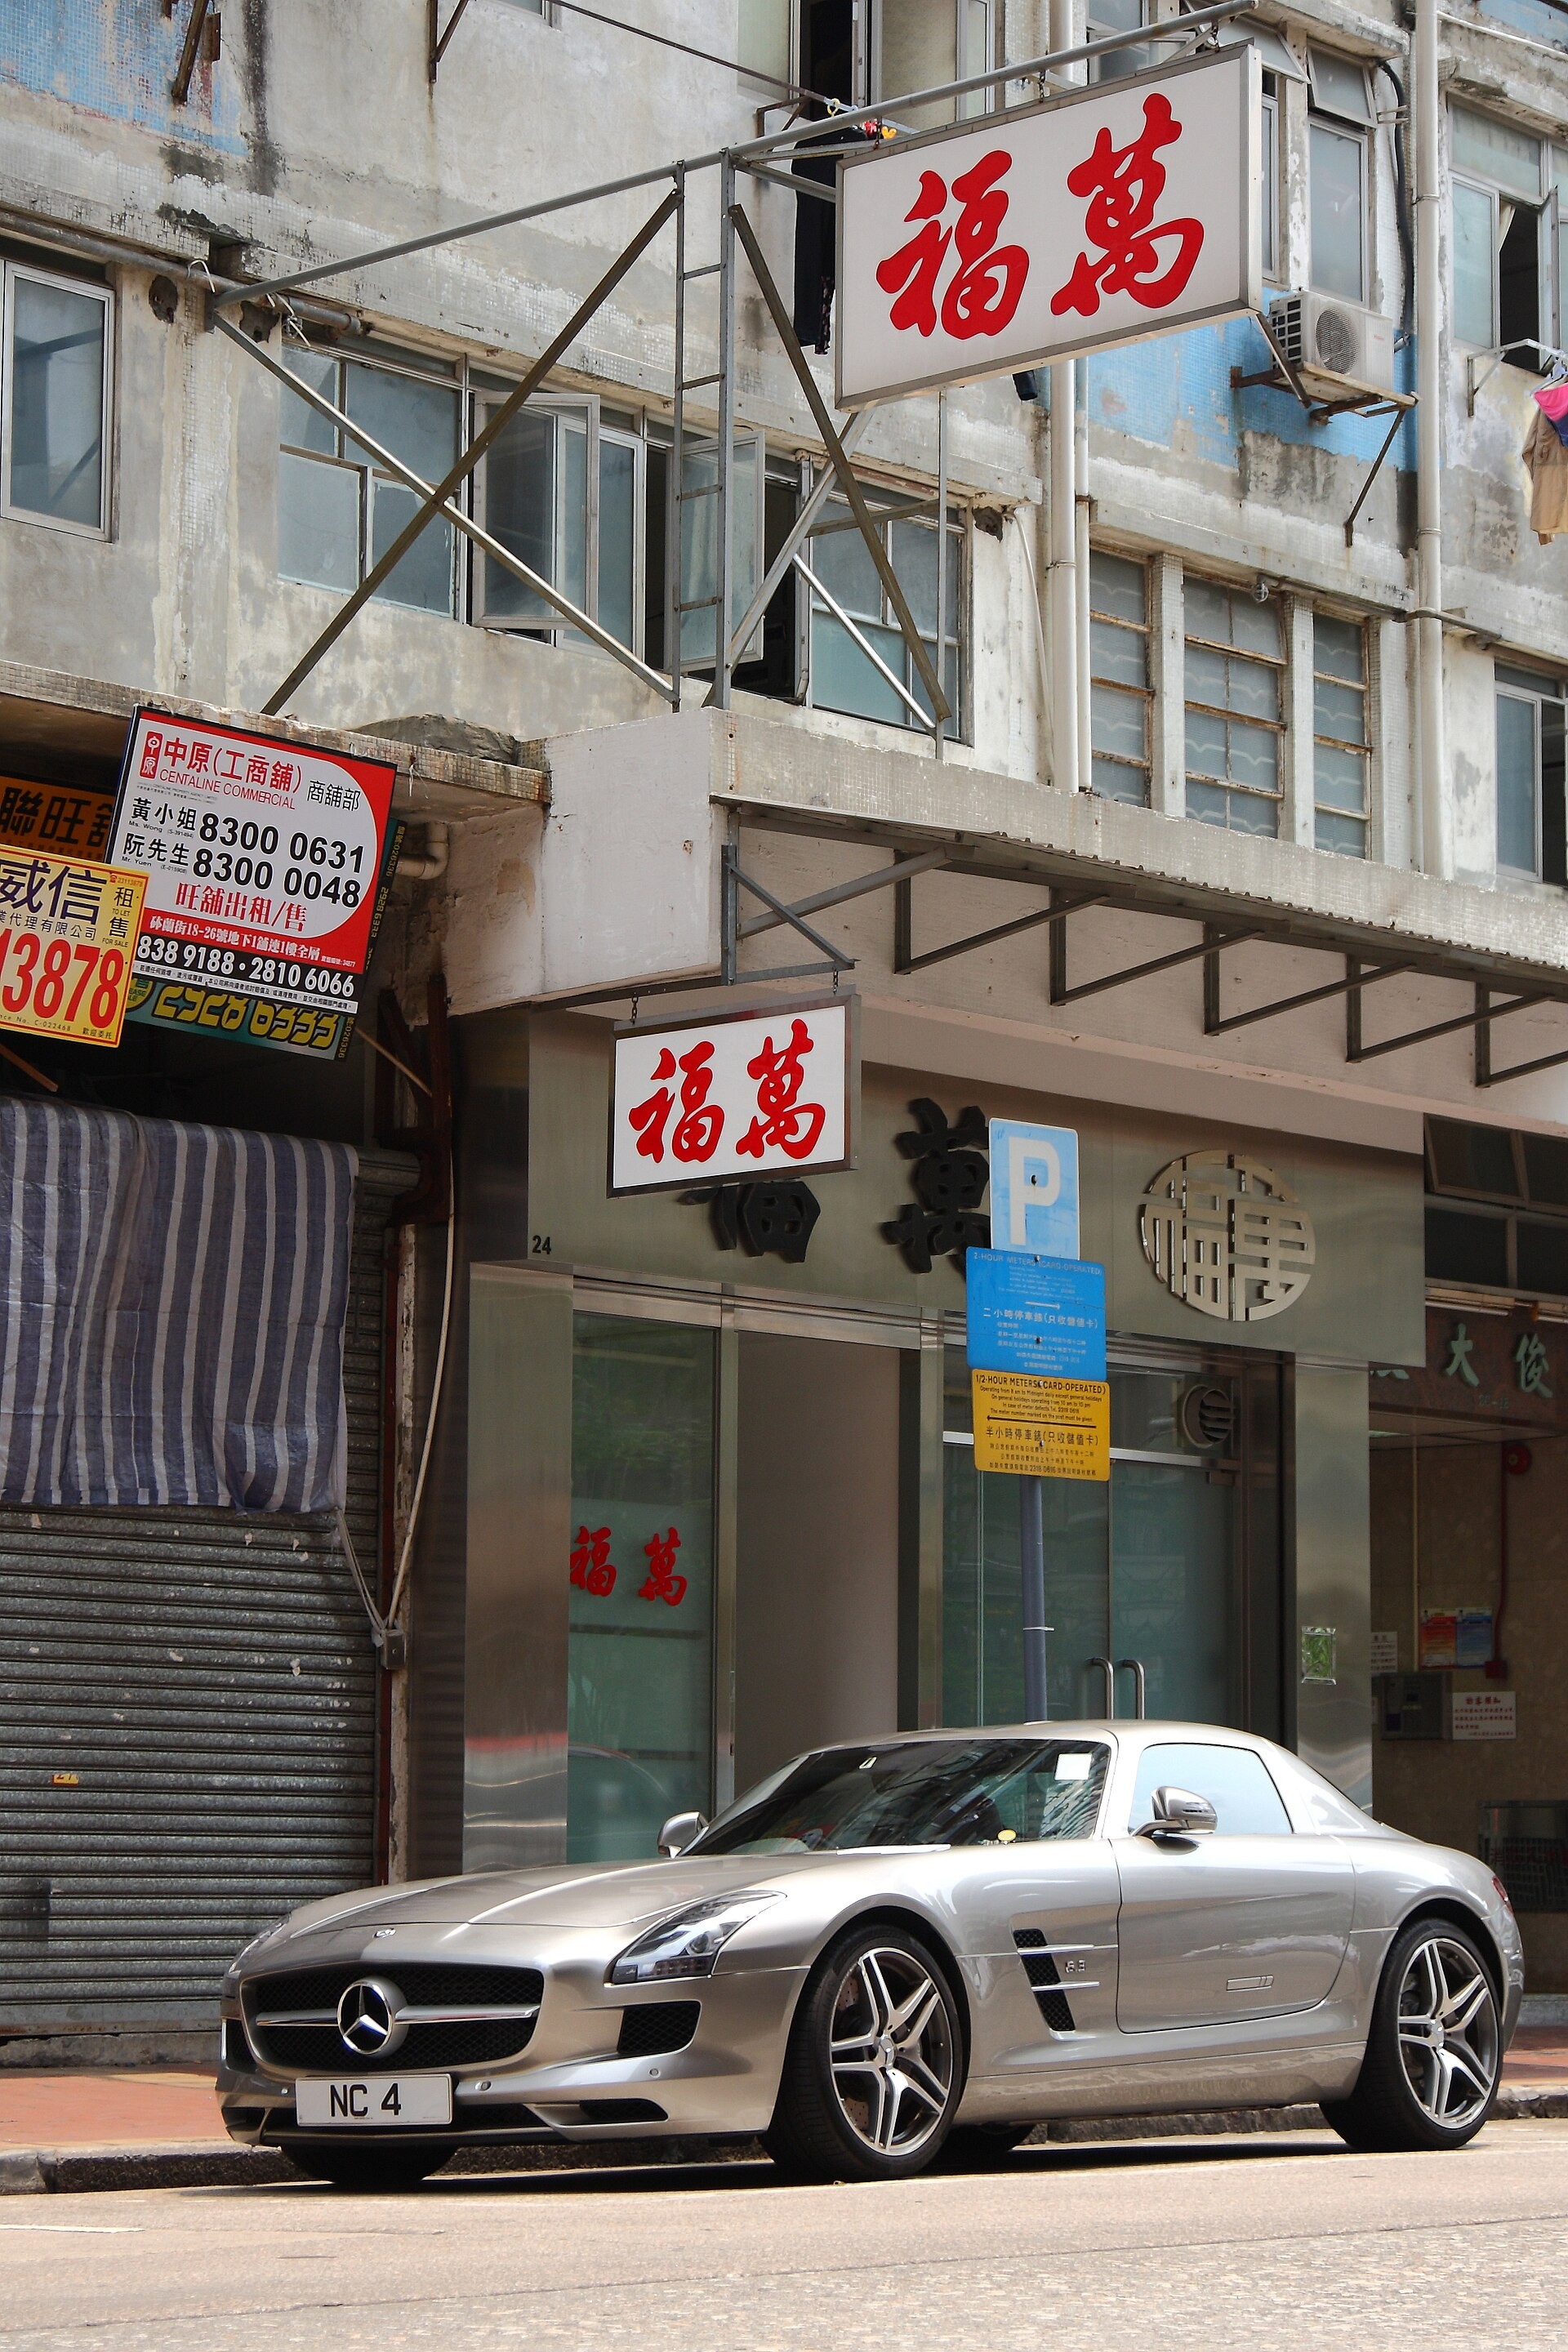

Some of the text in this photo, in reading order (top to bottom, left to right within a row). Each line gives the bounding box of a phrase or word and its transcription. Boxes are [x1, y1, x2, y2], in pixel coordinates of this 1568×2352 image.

[159, 769, 221, 793] CENTALINE
[223, 782, 296, 809] COMMERCIAL
[131, 797, 363, 873] 黃小姐 8300 0631
[143, 822, 163, 833] Wong
[122, 832, 189, 866] 阮先生
[193, 849, 273, 890] 8300
[283, 867, 361, 907] 0048
[134, 859, 152, 867] Yuen
[114, 886, 133, 908] 租
[109, 916, 129, 938] 售
[114, 939, 128, 948] SALE
[183, 944, 234, 974] 9188
[248, 956, 301, 987] 2810
[305, 967, 354, 997] 6066
[1009, 1135, 1061, 1245] P
[532, 1235, 552, 1255] 24
[973, 1252, 1004, 1263] 2-HOUR
[1007, 1256, 1036, 1266] METERS
[976, 1374, 1007, 1384] 1/2-HOUR
[1009, 1378, 1037, 1388] METERS
[330, 2082, 402, 2118] NC 4
